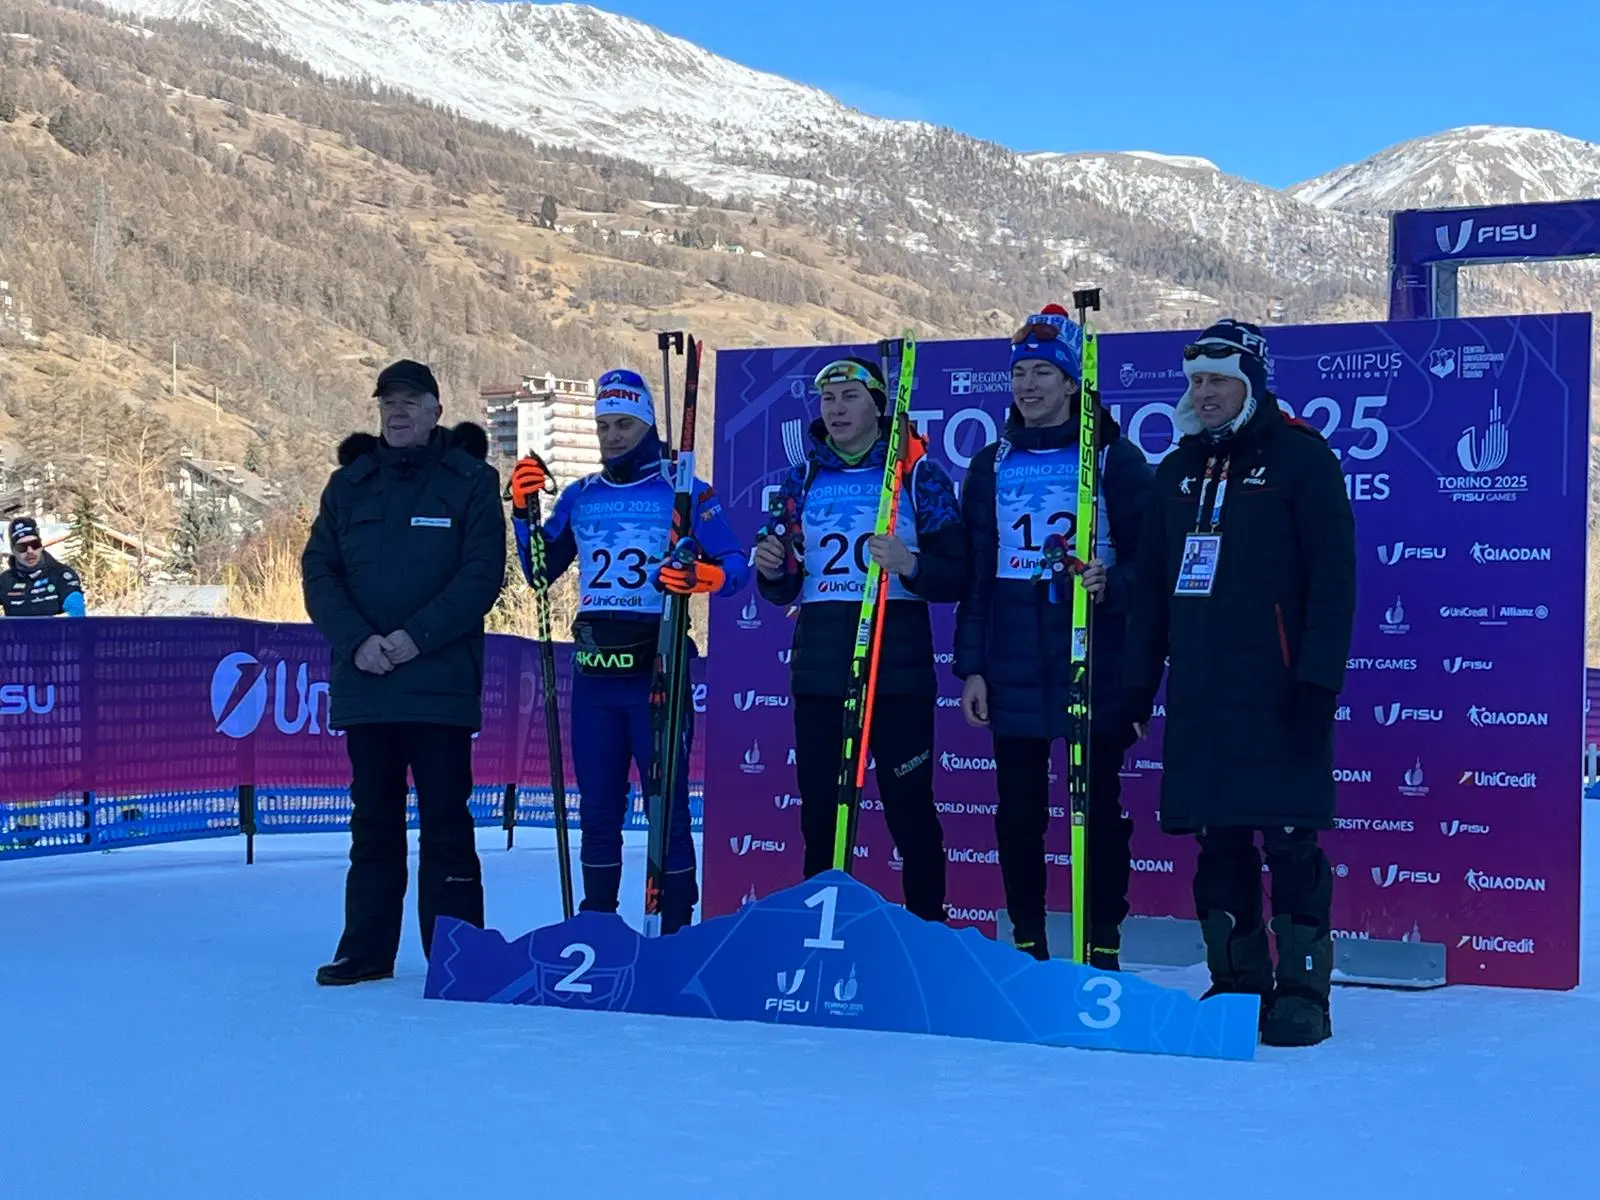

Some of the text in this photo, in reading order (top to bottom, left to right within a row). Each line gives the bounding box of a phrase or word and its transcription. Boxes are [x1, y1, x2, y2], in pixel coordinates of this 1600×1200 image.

[1478, 223, 1537, 243] FISU
[1080, 377, 1096, 490] FISCHER
[1437, 475, 1528, 489] TORINO 2025
[1452, 493, 1517, 502] FISU GAMES
[578, 500, 661, 515] TORINO 2025
[1404, 547, 1447, 559] FISU
[1484, 548, 1551, 562] QIAODAN
[588, 547, 648, 590] 23
[592, 595, 643, 607] UniCredit
[1450, 606, 1534, 618] UniCredit Allianz
[1375, 659, 1417, 671] GAMES
[1462, 659, 1493, 670] FISU
[755, 695, 789, 707] FISU
[1401, 708, 1443, 721] FISU
[1481, 711, 1548, 726] QIAODAN
[1475, 771, 1537, 788] UniCredit
[1372, 819, 1415, 832] GAMES
[1459, 824, 1490, 834] FISU
[752, 839, 785, 852] FISU
[948, 848, 1000, 865] UniCredit
[1399, 871, 1441, 884] FISU
[1478, 876, 1546, 892] QIAODAN
[803, 886, 845, 950] 1
[1472, 936, 1535, 954] UniCredit
[553, 943, 596, 994] 2
[765, 998, 810, 1013] FISU
[1077, 976, 1122, 1030] 3
